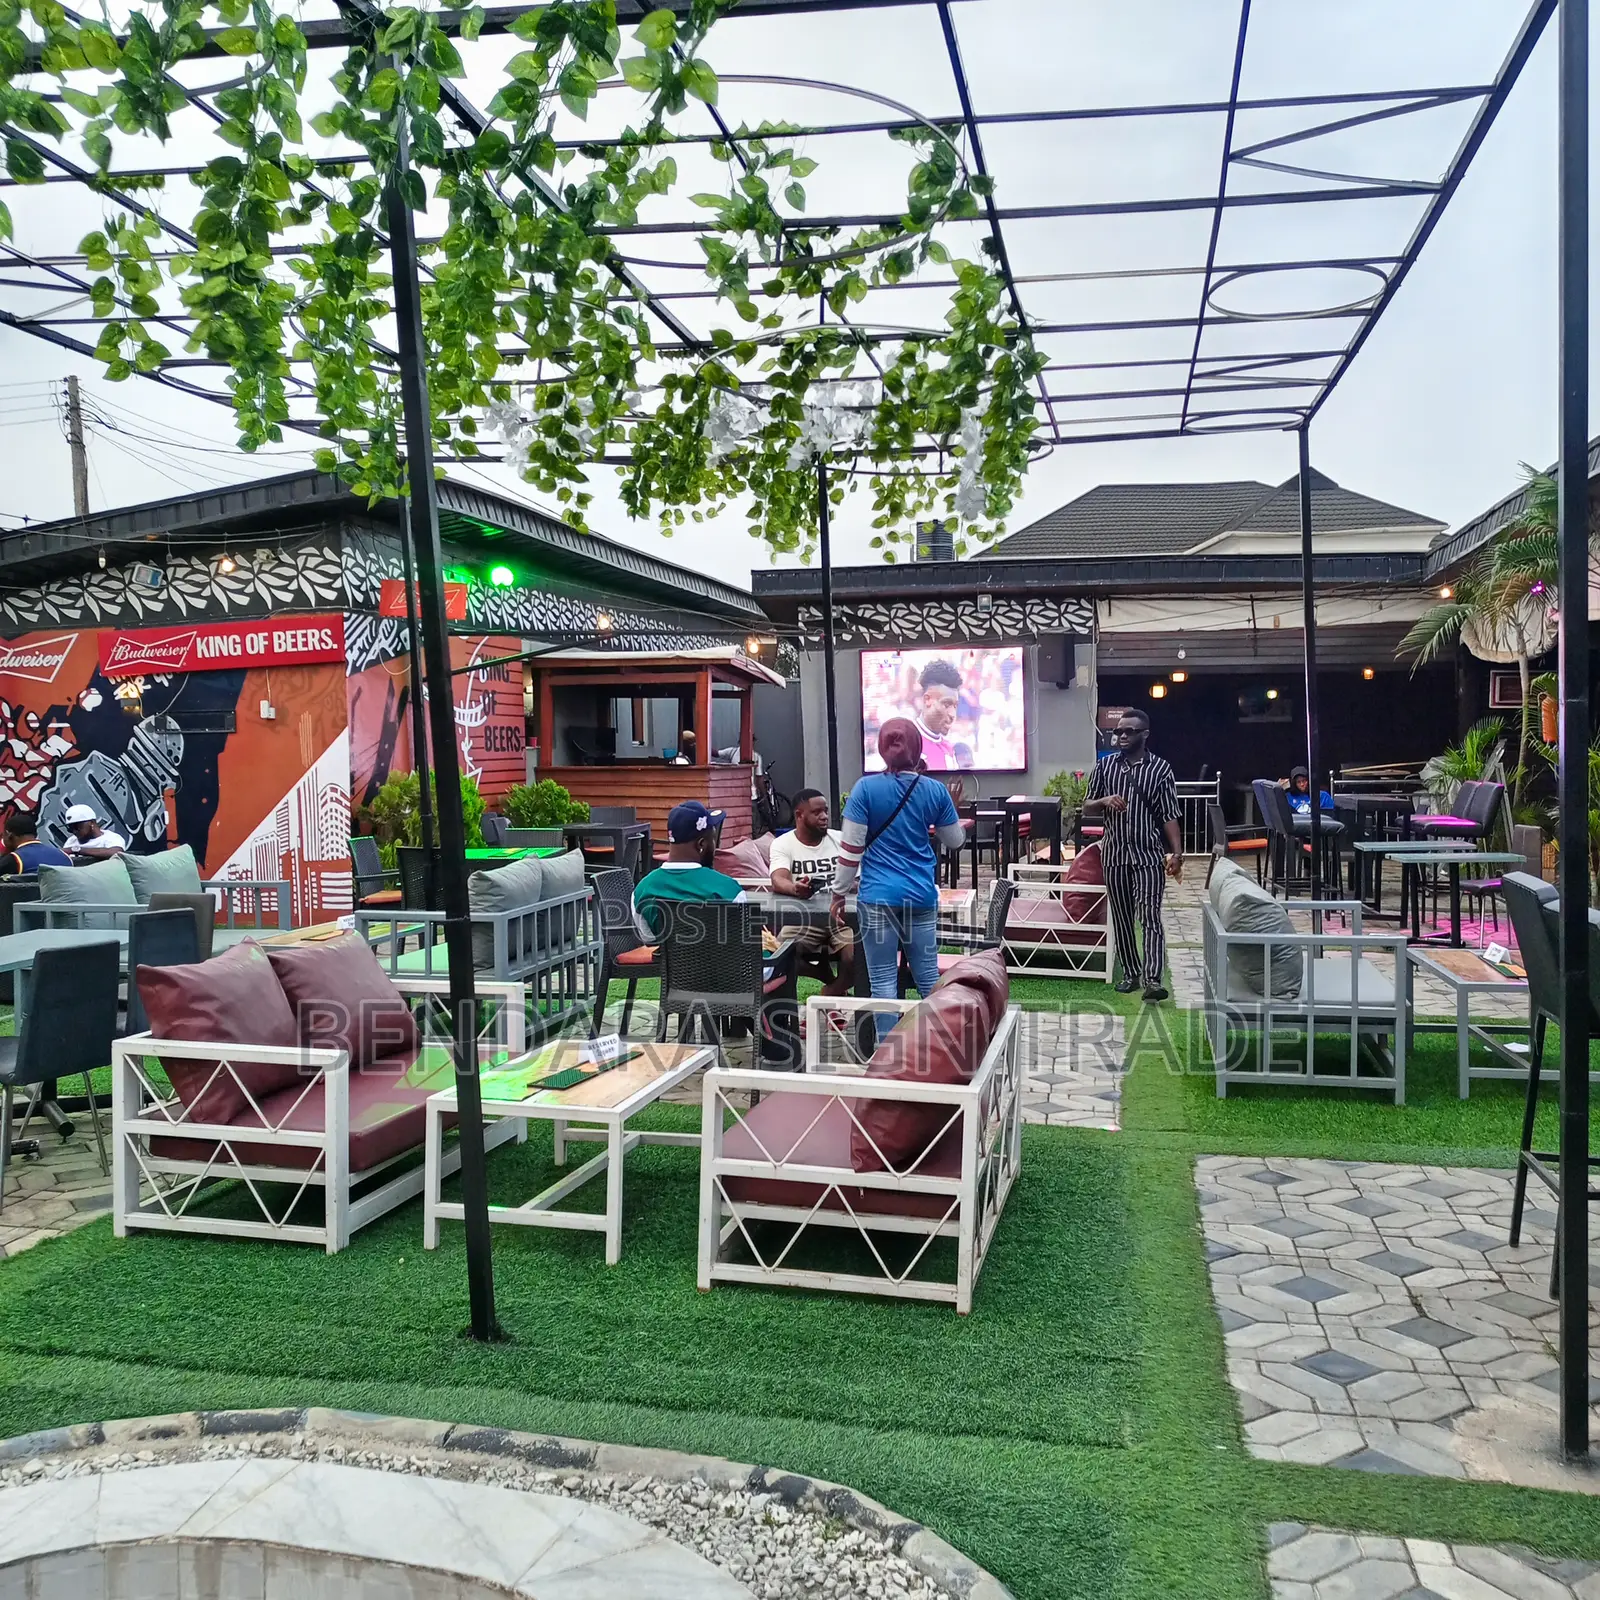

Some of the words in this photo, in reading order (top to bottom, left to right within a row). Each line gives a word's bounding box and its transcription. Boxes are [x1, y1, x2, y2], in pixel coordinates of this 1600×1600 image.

[112, 643, 189, 662] Budweiser
[196, 634, 242, 659] KING
[246, 632, 269, 655] OF
[273, 628, 338, 653] BEERS.
[483, 689, 497, 716] OF
[484, 725, 526, 753] BEERS.
